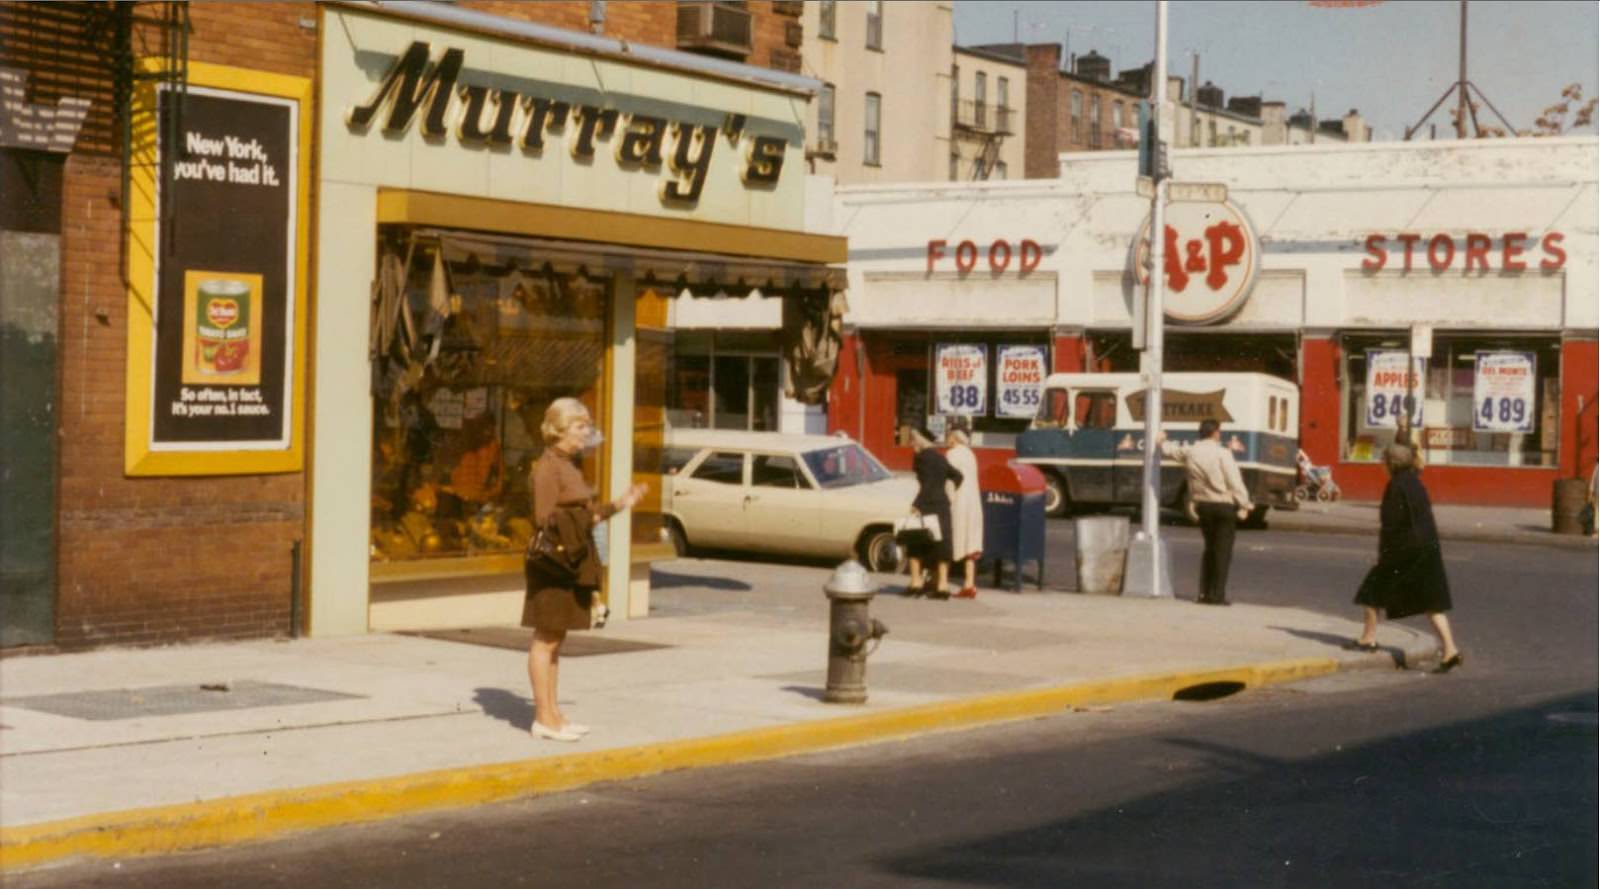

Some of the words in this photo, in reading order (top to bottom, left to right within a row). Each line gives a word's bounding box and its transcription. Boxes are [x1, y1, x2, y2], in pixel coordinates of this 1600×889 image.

[345, 41, 788, 204] Murray's
[186, 131, 224, 156] New
[224, 136, 267, 162] York,
[174, 158, 226, 181] you've
[228, 161, 260, 184] had
[262, 164, 280, 186] it.
[926, 239, 1042, 273] FOOD
[1143, 220, 1246, 293] A&P
[1361, 231, 1568, 274] STORES
[1002, 371, 1041, 384] LOINS
[1004, 357, 1039, 370] PORK
[181, 387, 196, 402] So
[171, 401, 188, 415] It's
[188, 404, 213, 418] your
[1481, 396, 1494, 422] 4
[1499, 397, 1526, 423] 89
